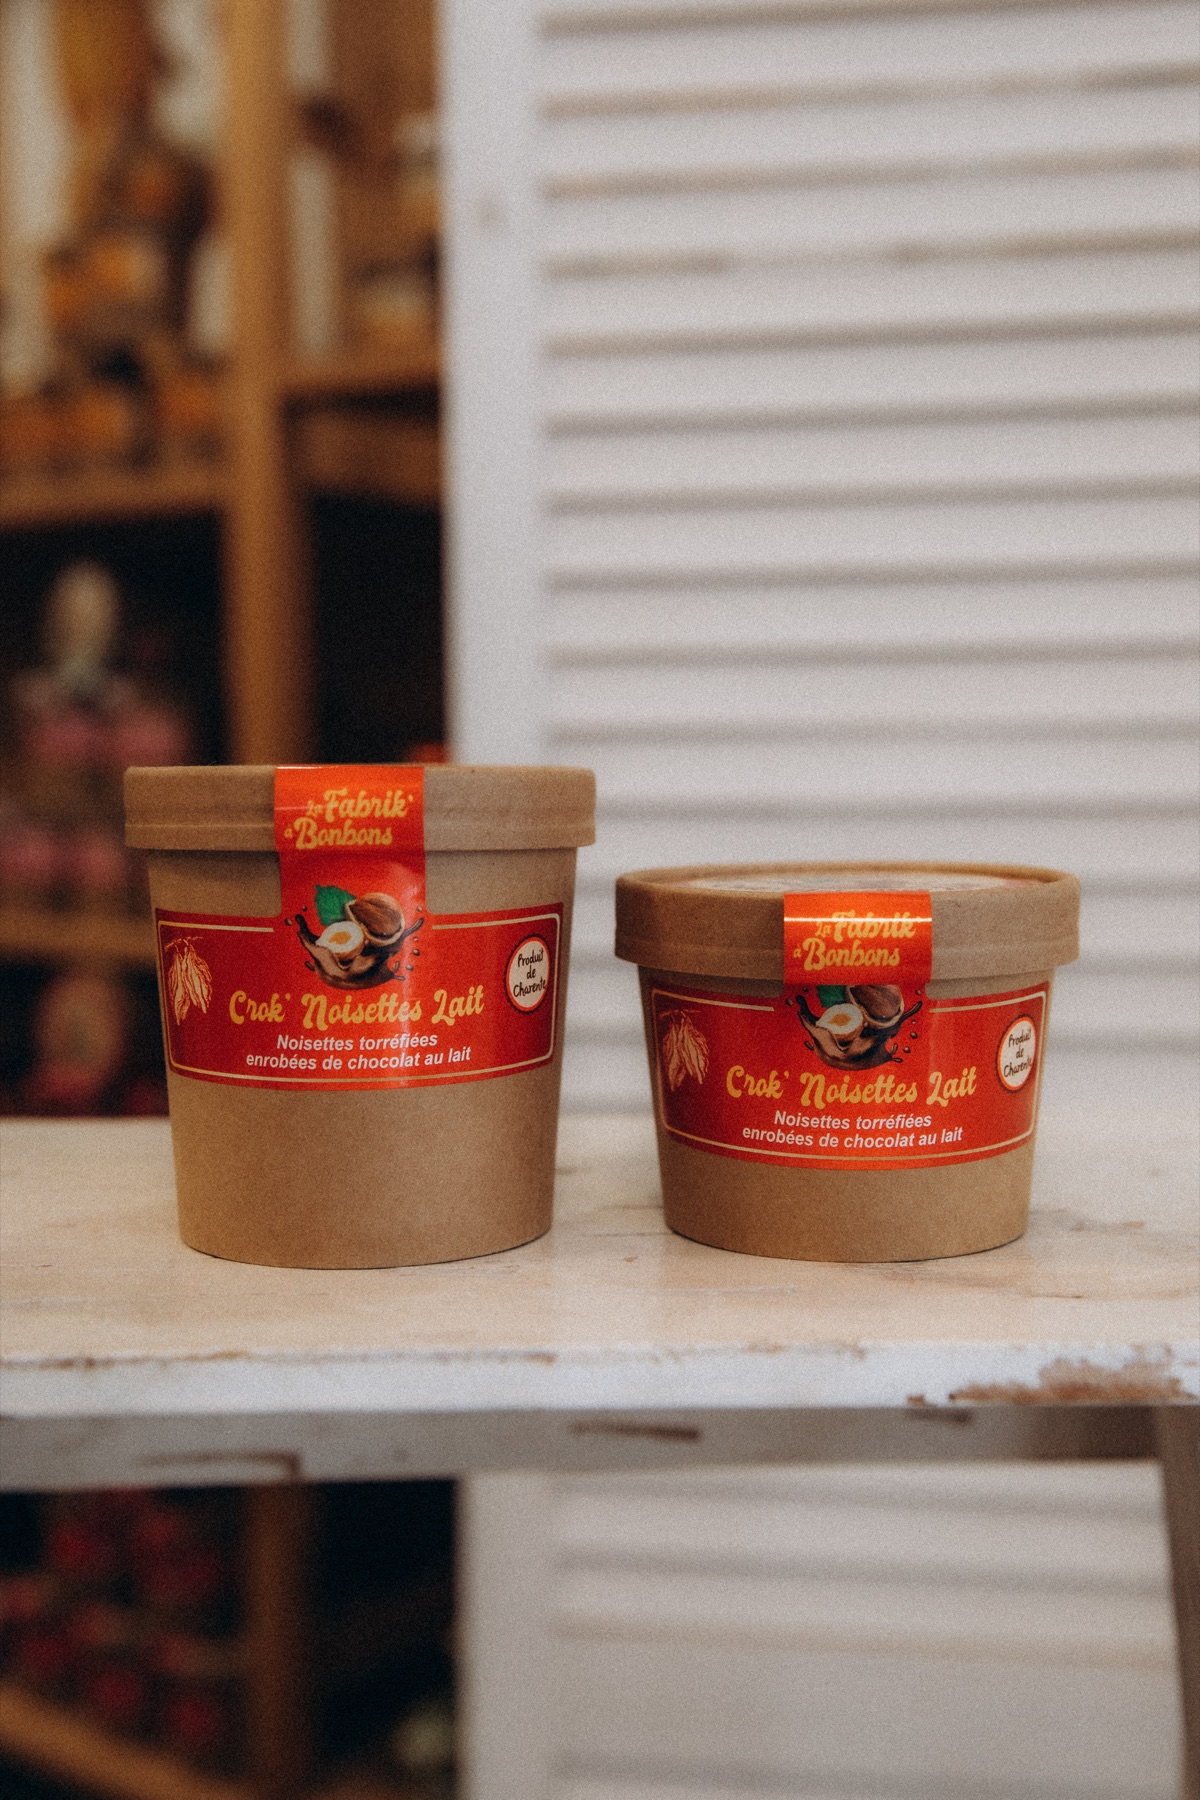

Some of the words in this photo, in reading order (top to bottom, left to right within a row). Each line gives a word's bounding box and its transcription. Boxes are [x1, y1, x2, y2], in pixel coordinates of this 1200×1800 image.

[294, 817, 393, 849] Bonbons
[518, 947, 544, 967] Produit
[802, 937, 900, 971] Bonbons
[526, 965, 536, 979] de
[513, 976, 546, 997] Charente
[229, 990, 291, 1024] Crok'
[302, 993, 422, 1031] Noisettes
[431, 985, 485, 1026] Lait
[276, 1034, 354, 1051] Noisettes
[359, 1033, 438, 1051] torréfiées
[246, 1054, 317, 1070] enrobées
[322, 1055, 342, 1070] de
[348, 1051, 420, 1070] chocolat
[424, 1053, 443, 1066] au
[448, 1046, 471, 1063] lait
[726, 1065, 789, 1098] Crok'
[800, 1072, 917, 1109] Noisettes
[926, 1066, 977, 1107] Lait
[774, 1110, 850, 1129] Noisettes
[855, 1113, 931, 1130] torréfiées
[742, 1126, 813, 1146] enrobées
[819, 1133, 839, 1148] de
[844, 1132, 914, 1149] chocolat
[918, 1131, 937, 1145] au
[941, 1126, 962, 1143] lait
